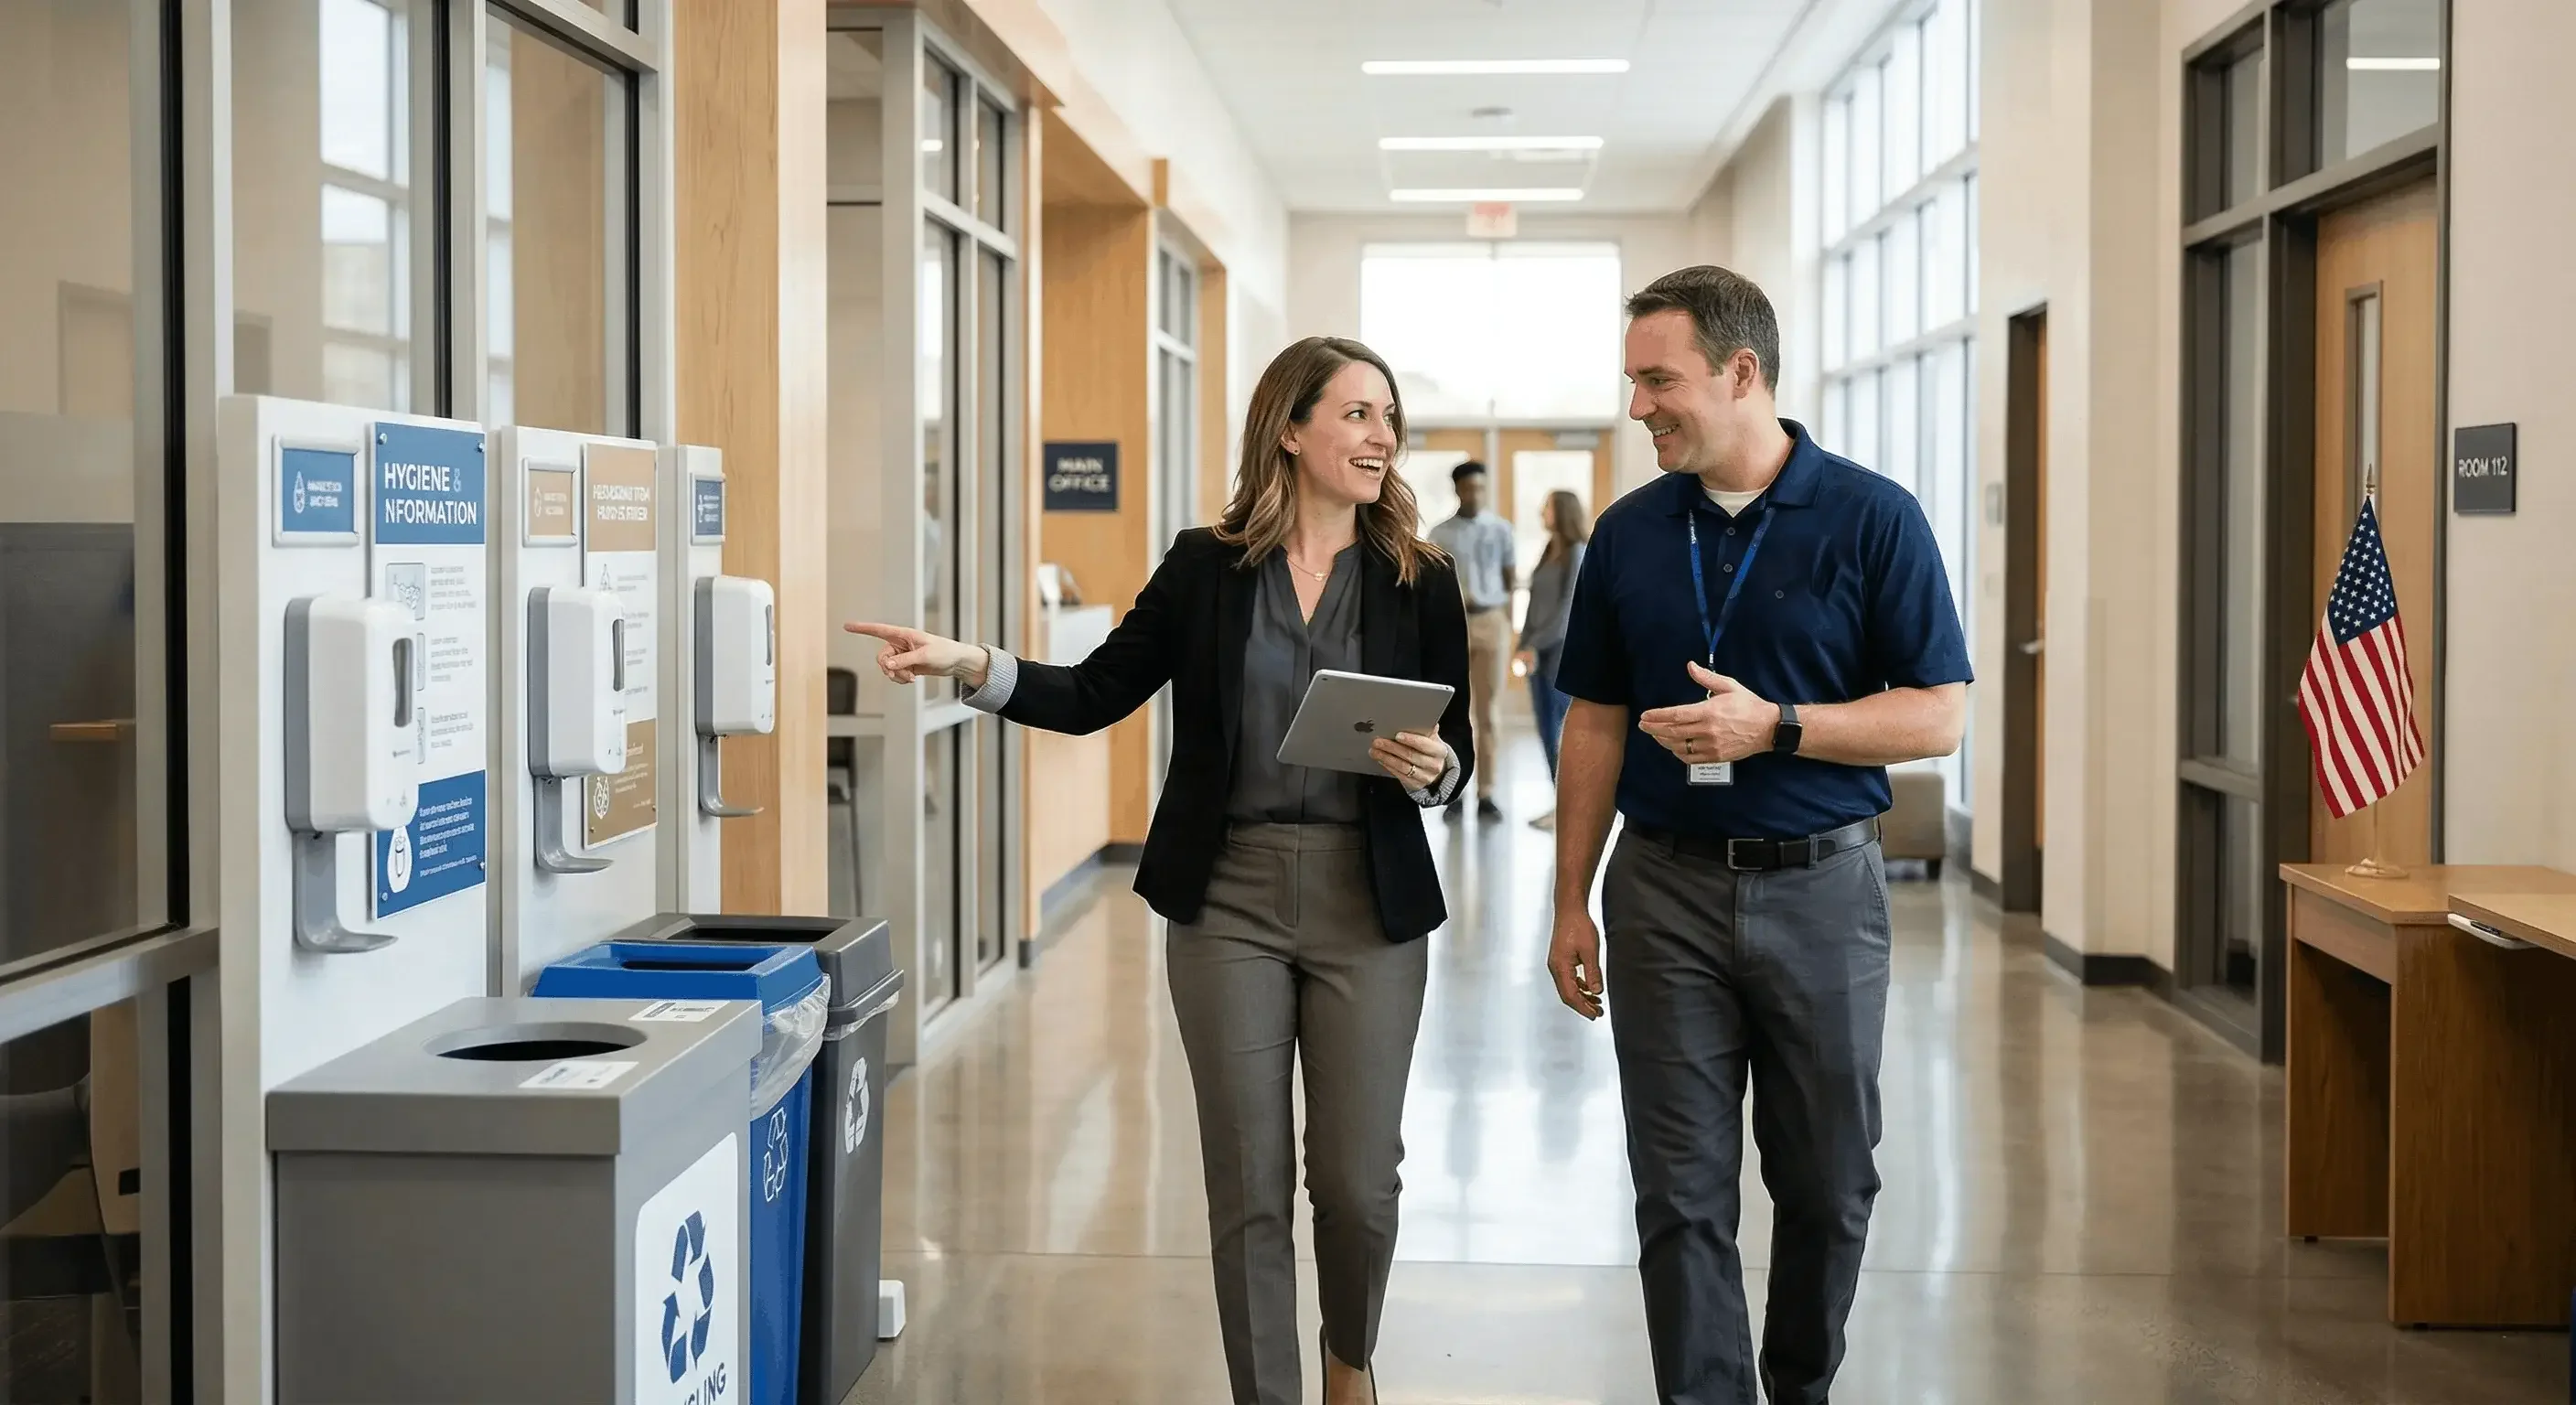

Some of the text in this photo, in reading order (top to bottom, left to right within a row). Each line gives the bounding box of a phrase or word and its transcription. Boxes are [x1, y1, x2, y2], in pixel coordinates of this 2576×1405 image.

[1057, 456, 1104, 474] MAIN
[2458, 456, 2508, 478] ROOM 112
[384, 462, 462, 493] HYGIENE &
[385, 499, 478, 525] NFORMATION
